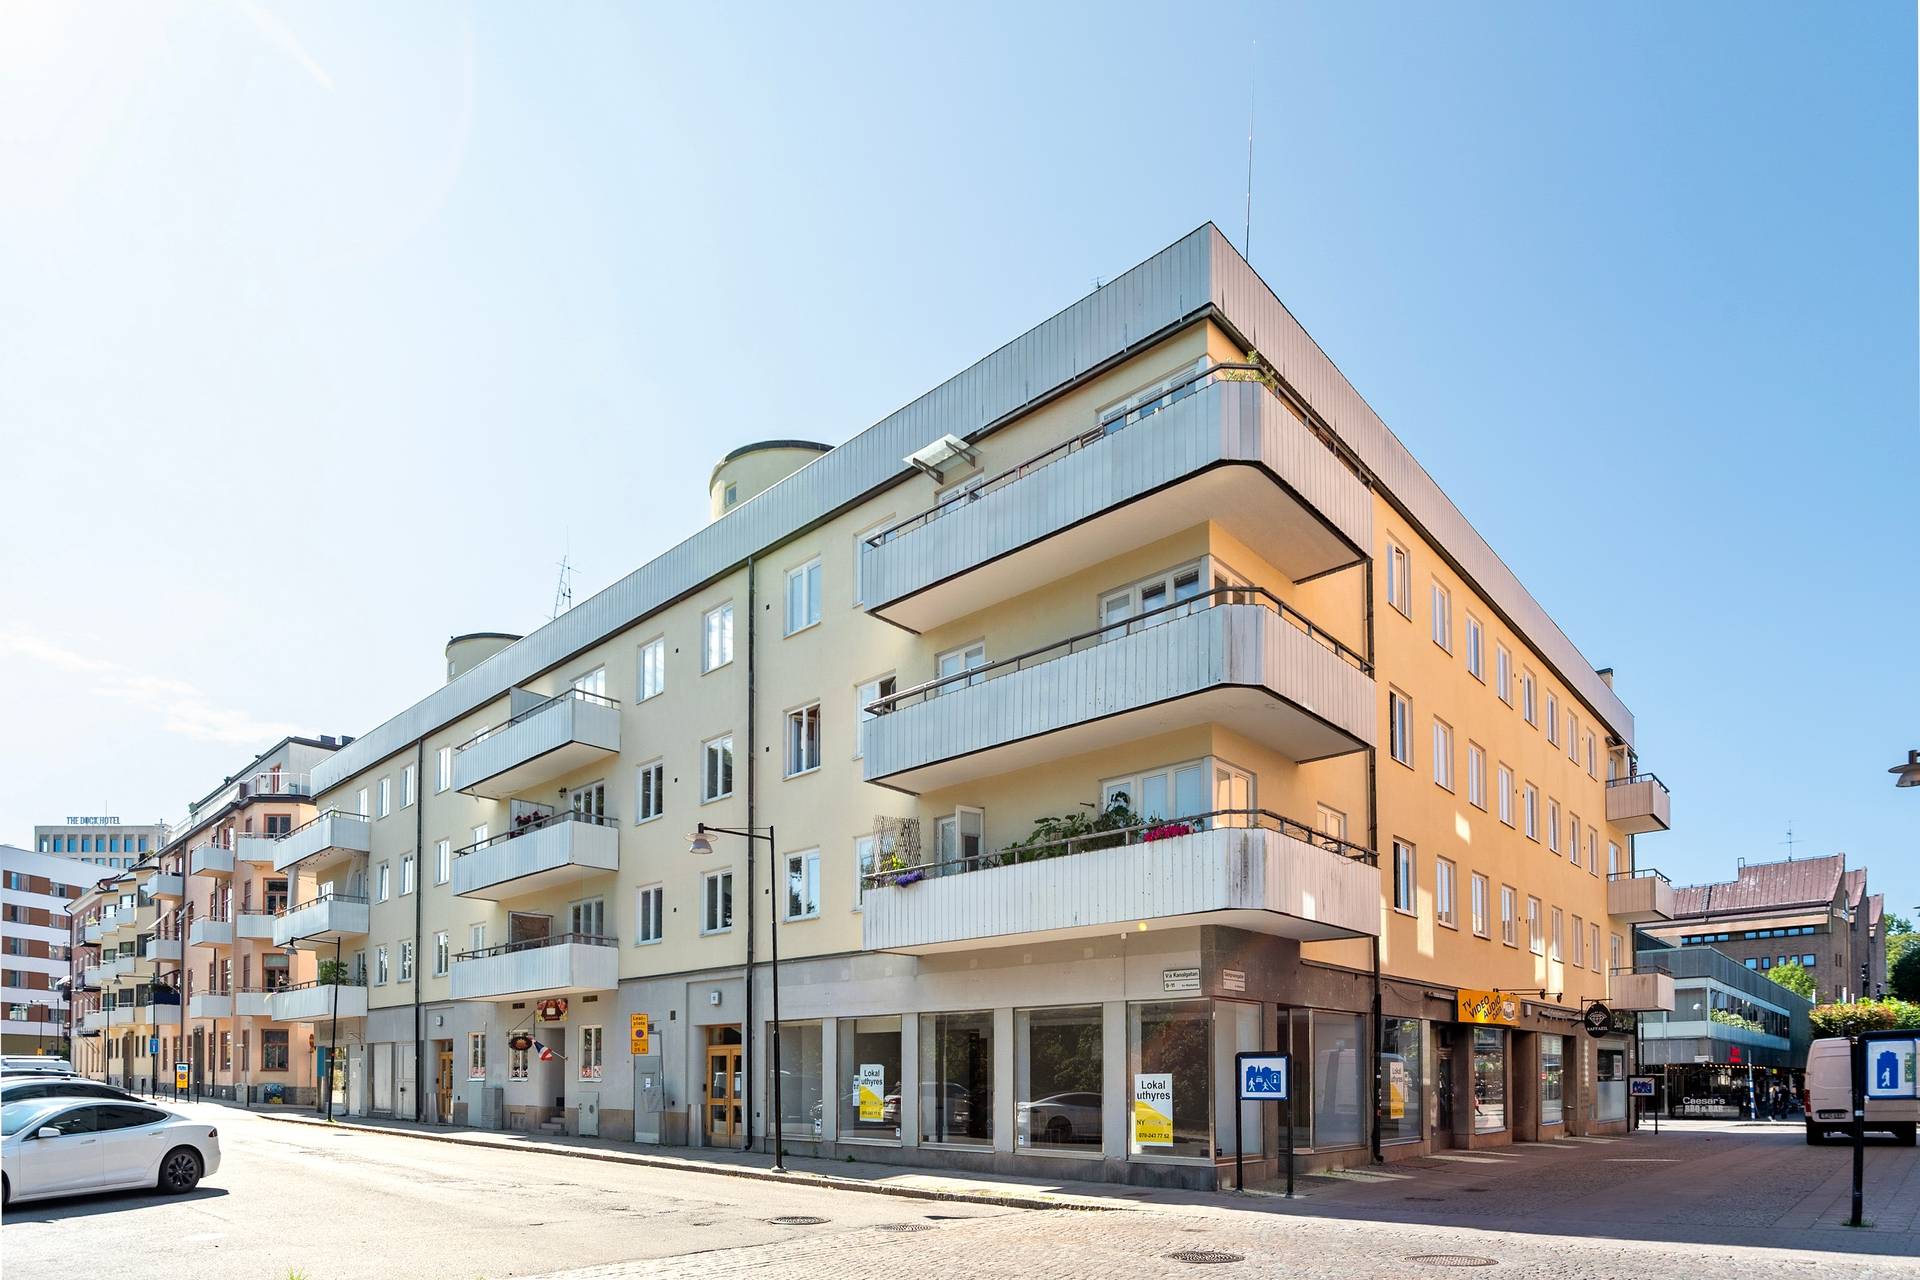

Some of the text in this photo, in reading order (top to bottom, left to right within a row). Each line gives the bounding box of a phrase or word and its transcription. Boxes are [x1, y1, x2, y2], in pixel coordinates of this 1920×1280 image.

[66, 816, 79, 825] THE
[100, 816, 121, 825] HOTEL
[1462, 998, 1472, 1011] TV
[1469, 995, 1490, 1018] VIDEO
[1484, 995, 1501, 1019] AUDIO
[864, 1069, 881, 1077] Lokal
[861, 1078, 883, 1087] uthyres
[1141, 1080, 1166, 1089] Lokal
[1136, 1091, 1171, 1102] uthyres
[1682, 1096, 1726, 1105] Caesar's
